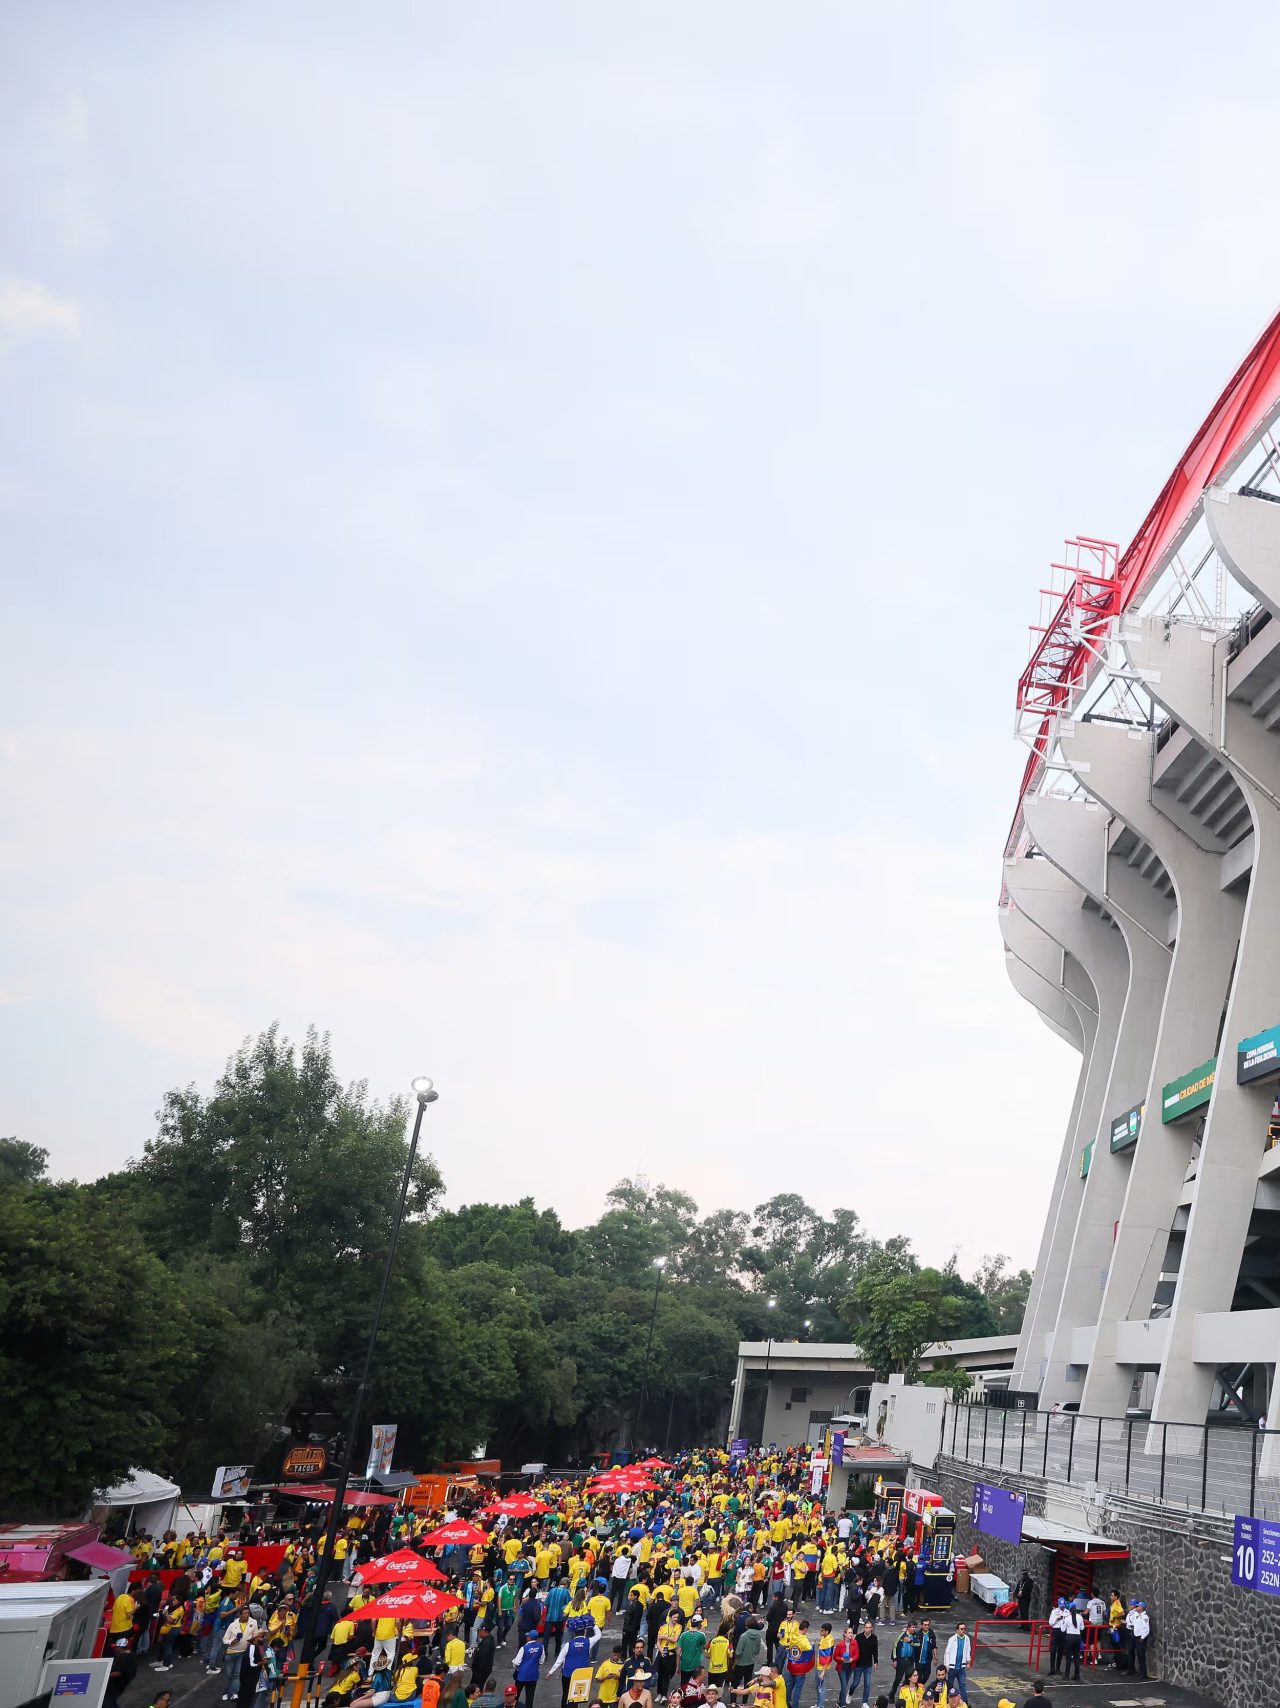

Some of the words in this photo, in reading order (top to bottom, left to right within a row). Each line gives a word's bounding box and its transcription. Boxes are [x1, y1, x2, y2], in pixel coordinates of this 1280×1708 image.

[294, 1465, 314, 1473] TACOS
[973, 1502, 979, 1524] 9
[441, 1529, 469, 1538] Coca-Cola
[386, 1560, 420, 1570] Coca-Cola
[1236, 1545, 1255, 1581] 10
[376, 1595, 417, 1606] Coca-Cola
